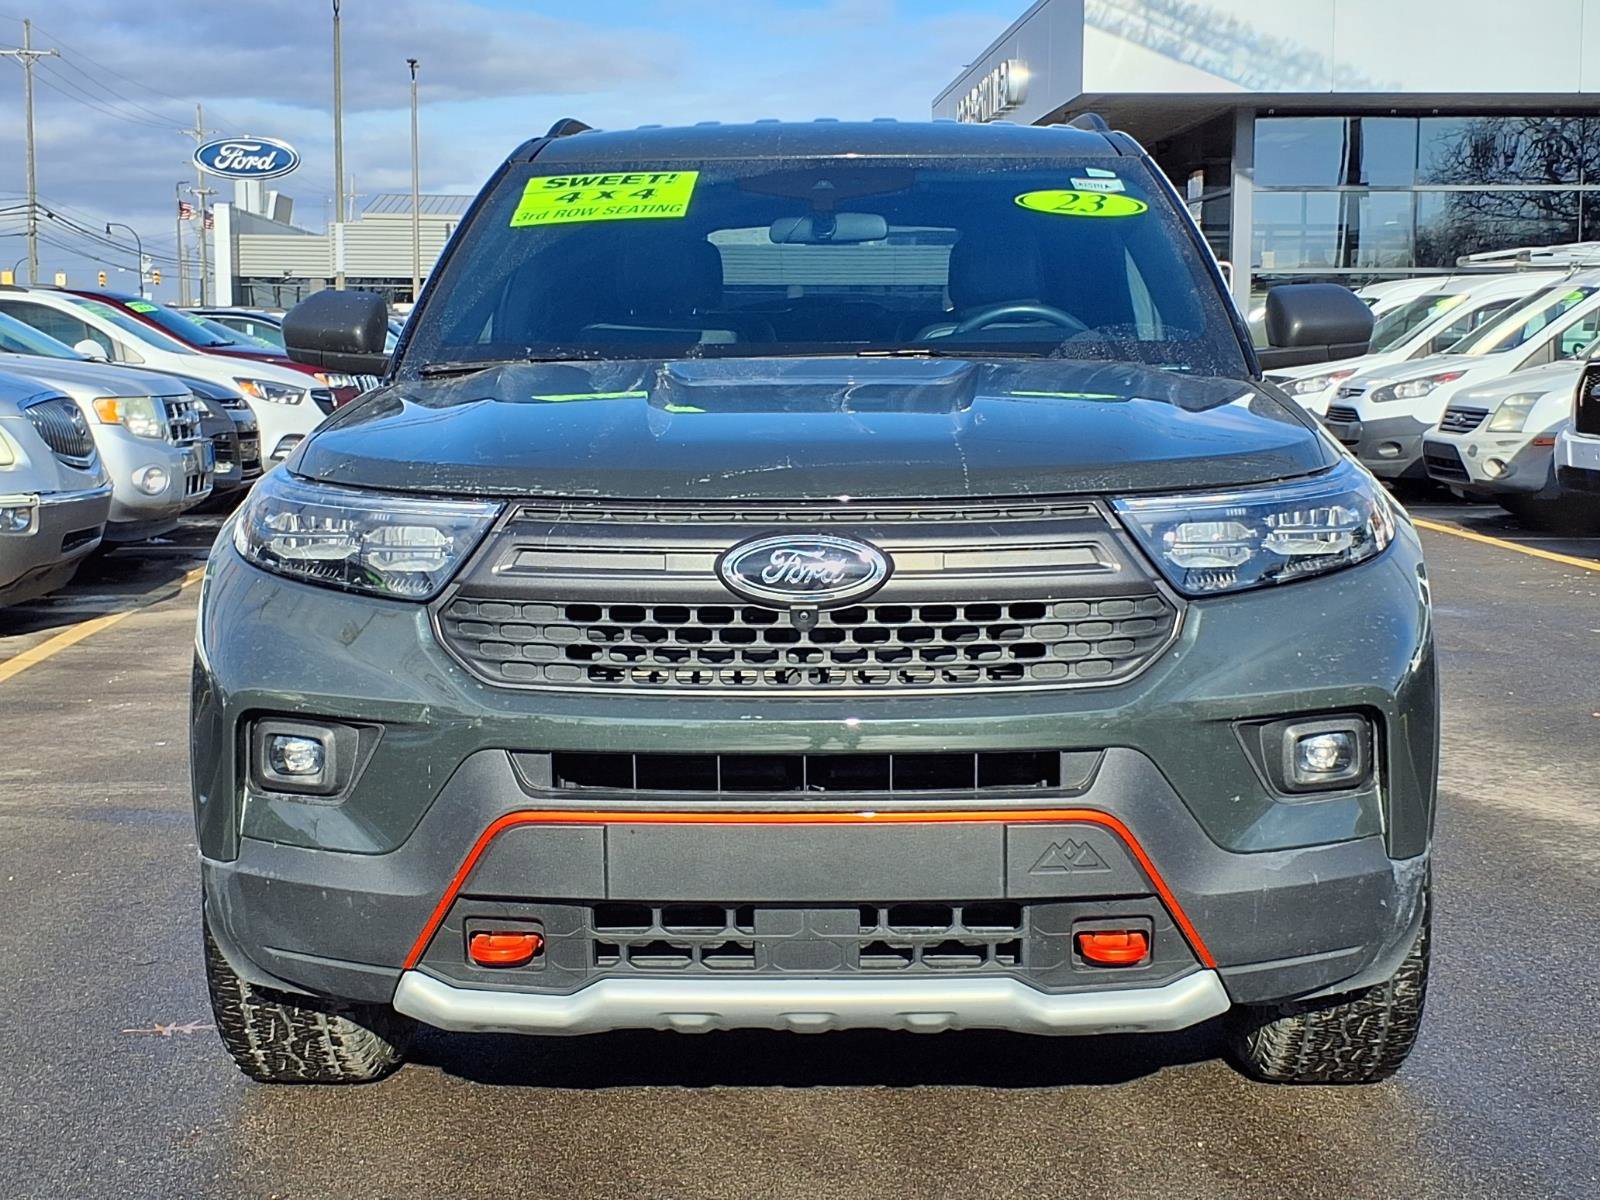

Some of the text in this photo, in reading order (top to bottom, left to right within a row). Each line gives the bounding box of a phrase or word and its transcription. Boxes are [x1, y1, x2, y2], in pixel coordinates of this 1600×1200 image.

[214, 144, 276, 170] Ford
[543, 174, 678, 189] SWEET!
[555, 191, 580, 204] 4
[629, 188, 656, 200] 4
[1053, 193, 1107, 213] 23
[516, 203, 683, 222] 3rd ROW SEATING
[761, 549, 847, 584] Ford
